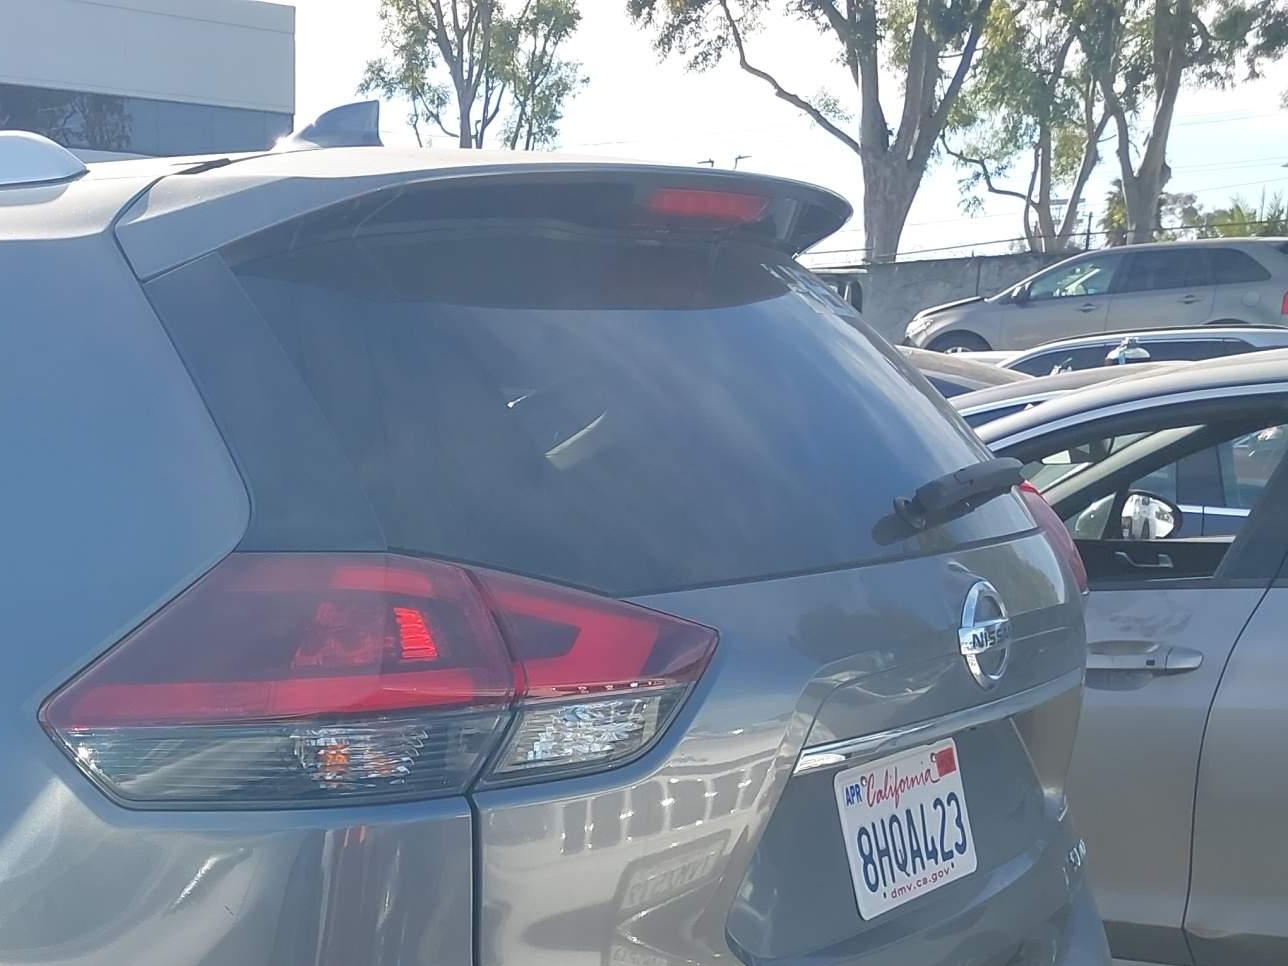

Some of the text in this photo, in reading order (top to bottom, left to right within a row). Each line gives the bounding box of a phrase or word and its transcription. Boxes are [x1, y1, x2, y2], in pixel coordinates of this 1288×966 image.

[971, 625, 1013, 650] NISS
[845, 783, 862, 807] APR
[865, 761, 941, 809] California
[857, 791, 967, 893] 8HQA423
[890, 866, 950, 899] dmv.ca.gov
